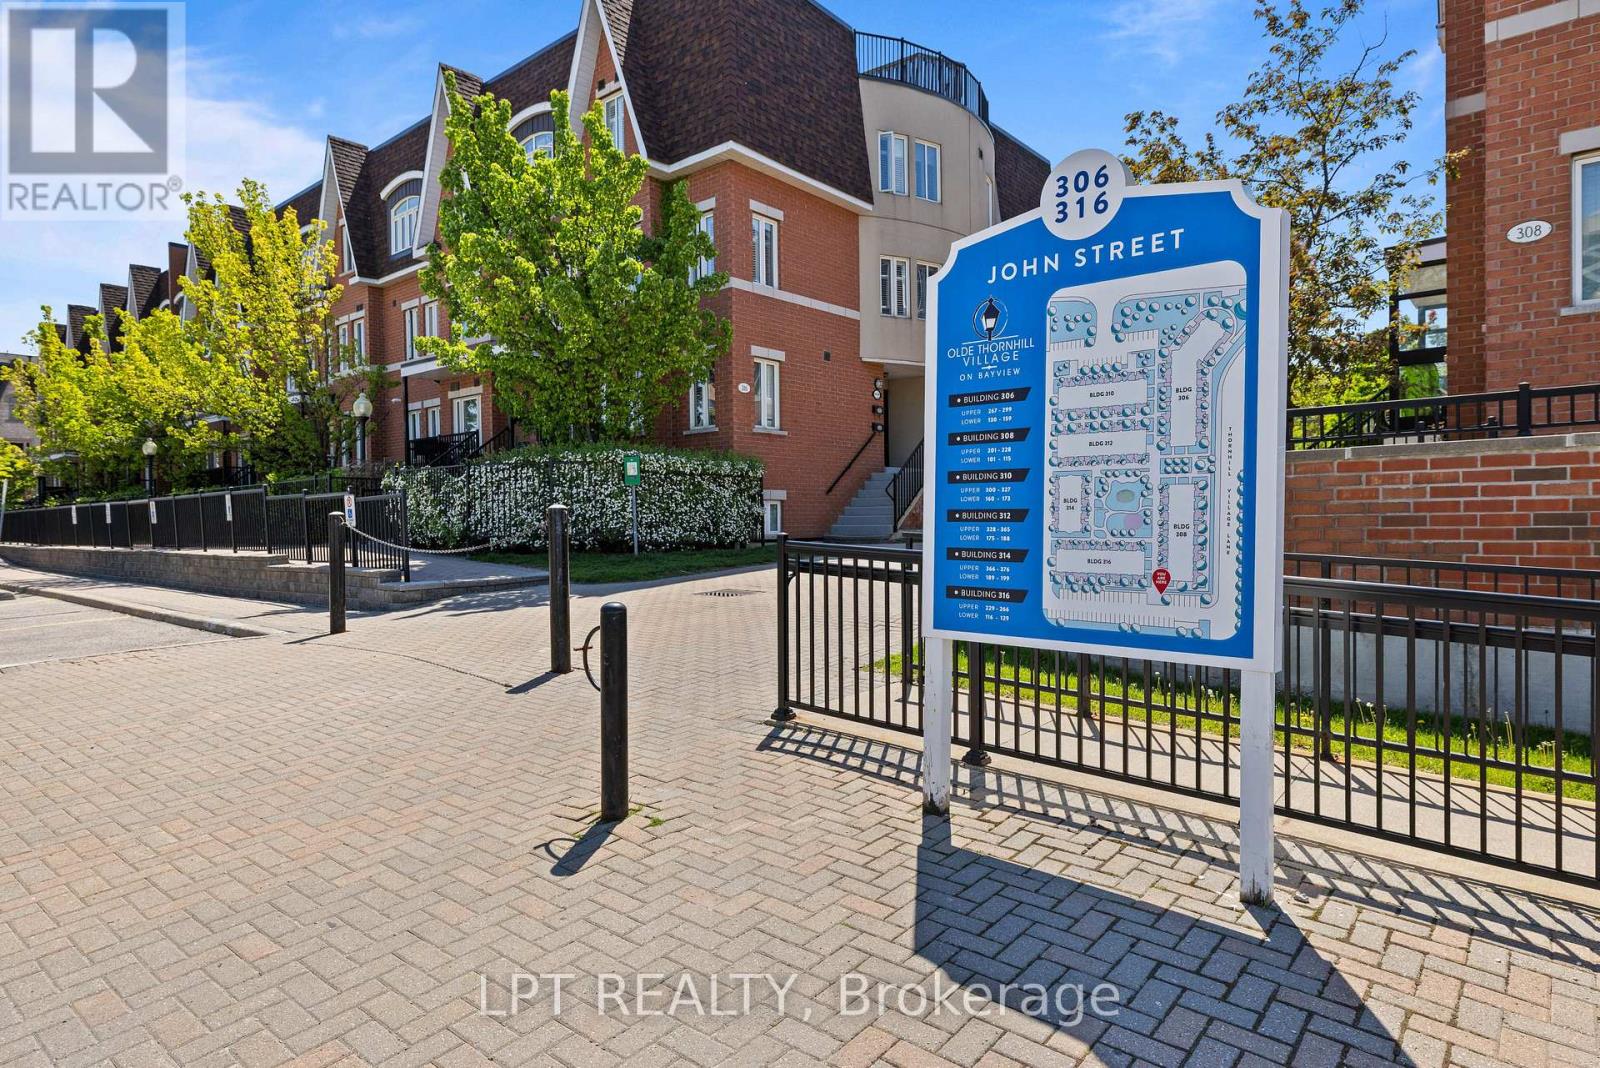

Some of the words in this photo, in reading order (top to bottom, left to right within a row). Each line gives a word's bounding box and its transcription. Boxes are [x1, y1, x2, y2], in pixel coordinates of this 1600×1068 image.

[1055, 164, 1109, 198] 306
[1055, 190, 1109, 224] 316
[1516, 224, 1542, 240] 308
[987, 252, 1060, 284] JOHN
[1074, 228, 1185, 268] STREET
[947, 345, 974, 359] OLDE
[978, 337, 1035, 354] THORNHILL
[963, 350, 1019, 367] VILLAGE
[959, 373, 973, 381] ON
[978, 367, 1021, 379] BAYVIEW
[963, 394, 999, 403] BUILDING
[962, 433, 998, 442] BUILDING
[962, 472, 998, 481] BUILDING
[961, 550, 997, 559] BUILDING
[961, 590, 997, 598] BUILDING
